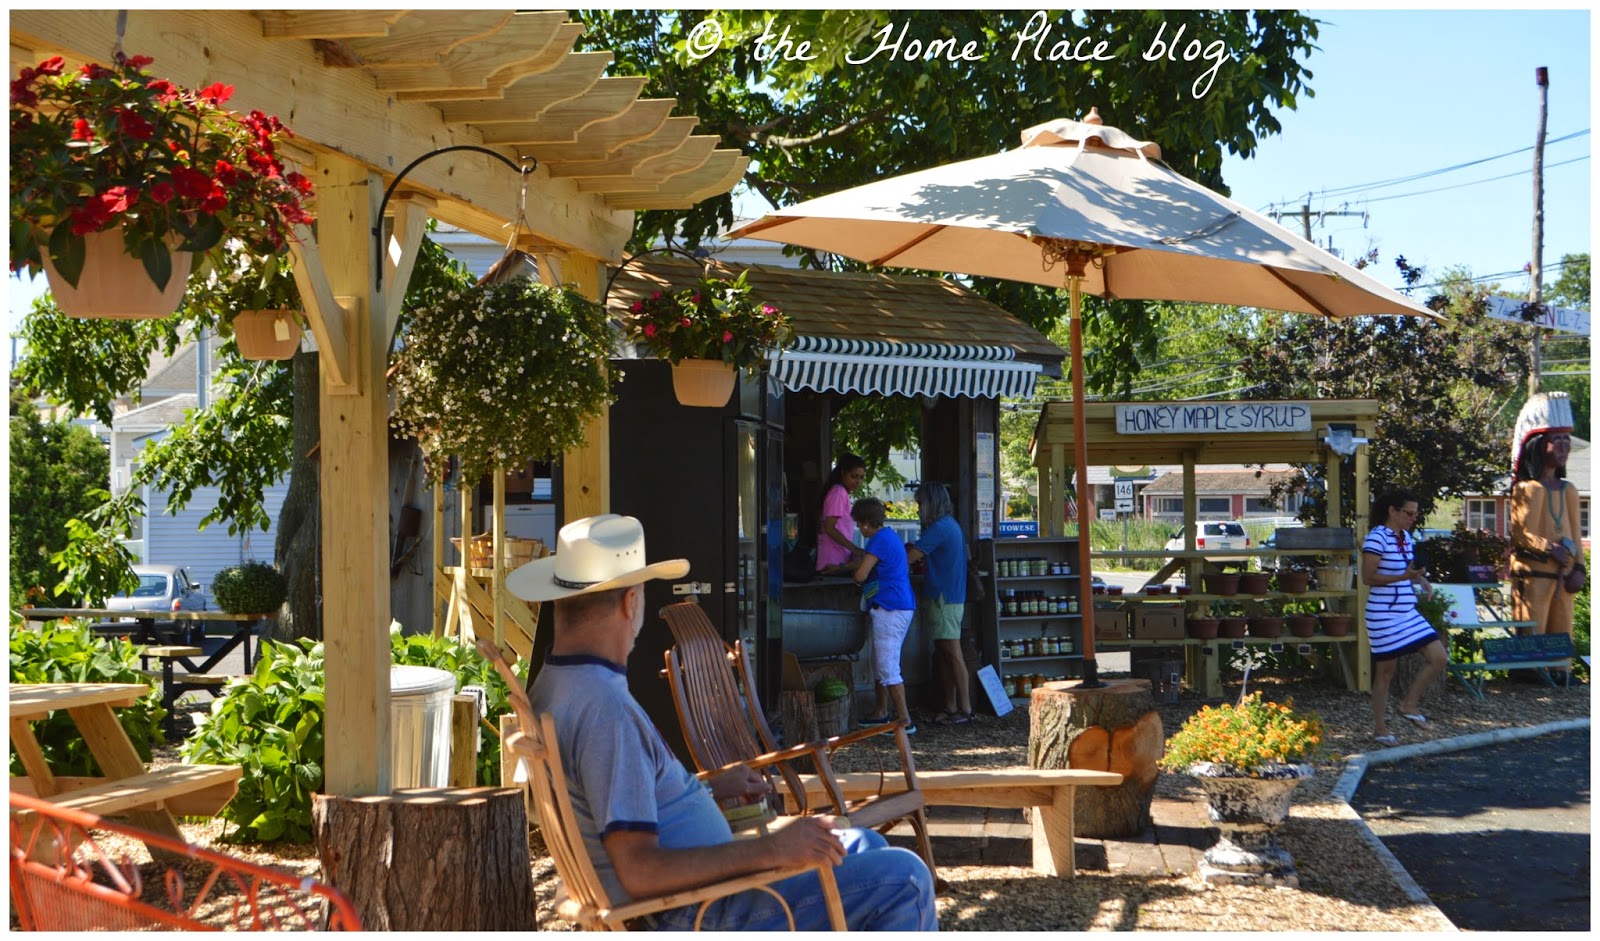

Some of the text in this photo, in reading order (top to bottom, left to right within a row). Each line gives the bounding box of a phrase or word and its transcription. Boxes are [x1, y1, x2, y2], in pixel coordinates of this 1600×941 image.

[1124, 405, 1306, 432] HONEY MAPLE SYRUP
[1116, 484, 1132, 496] 146
